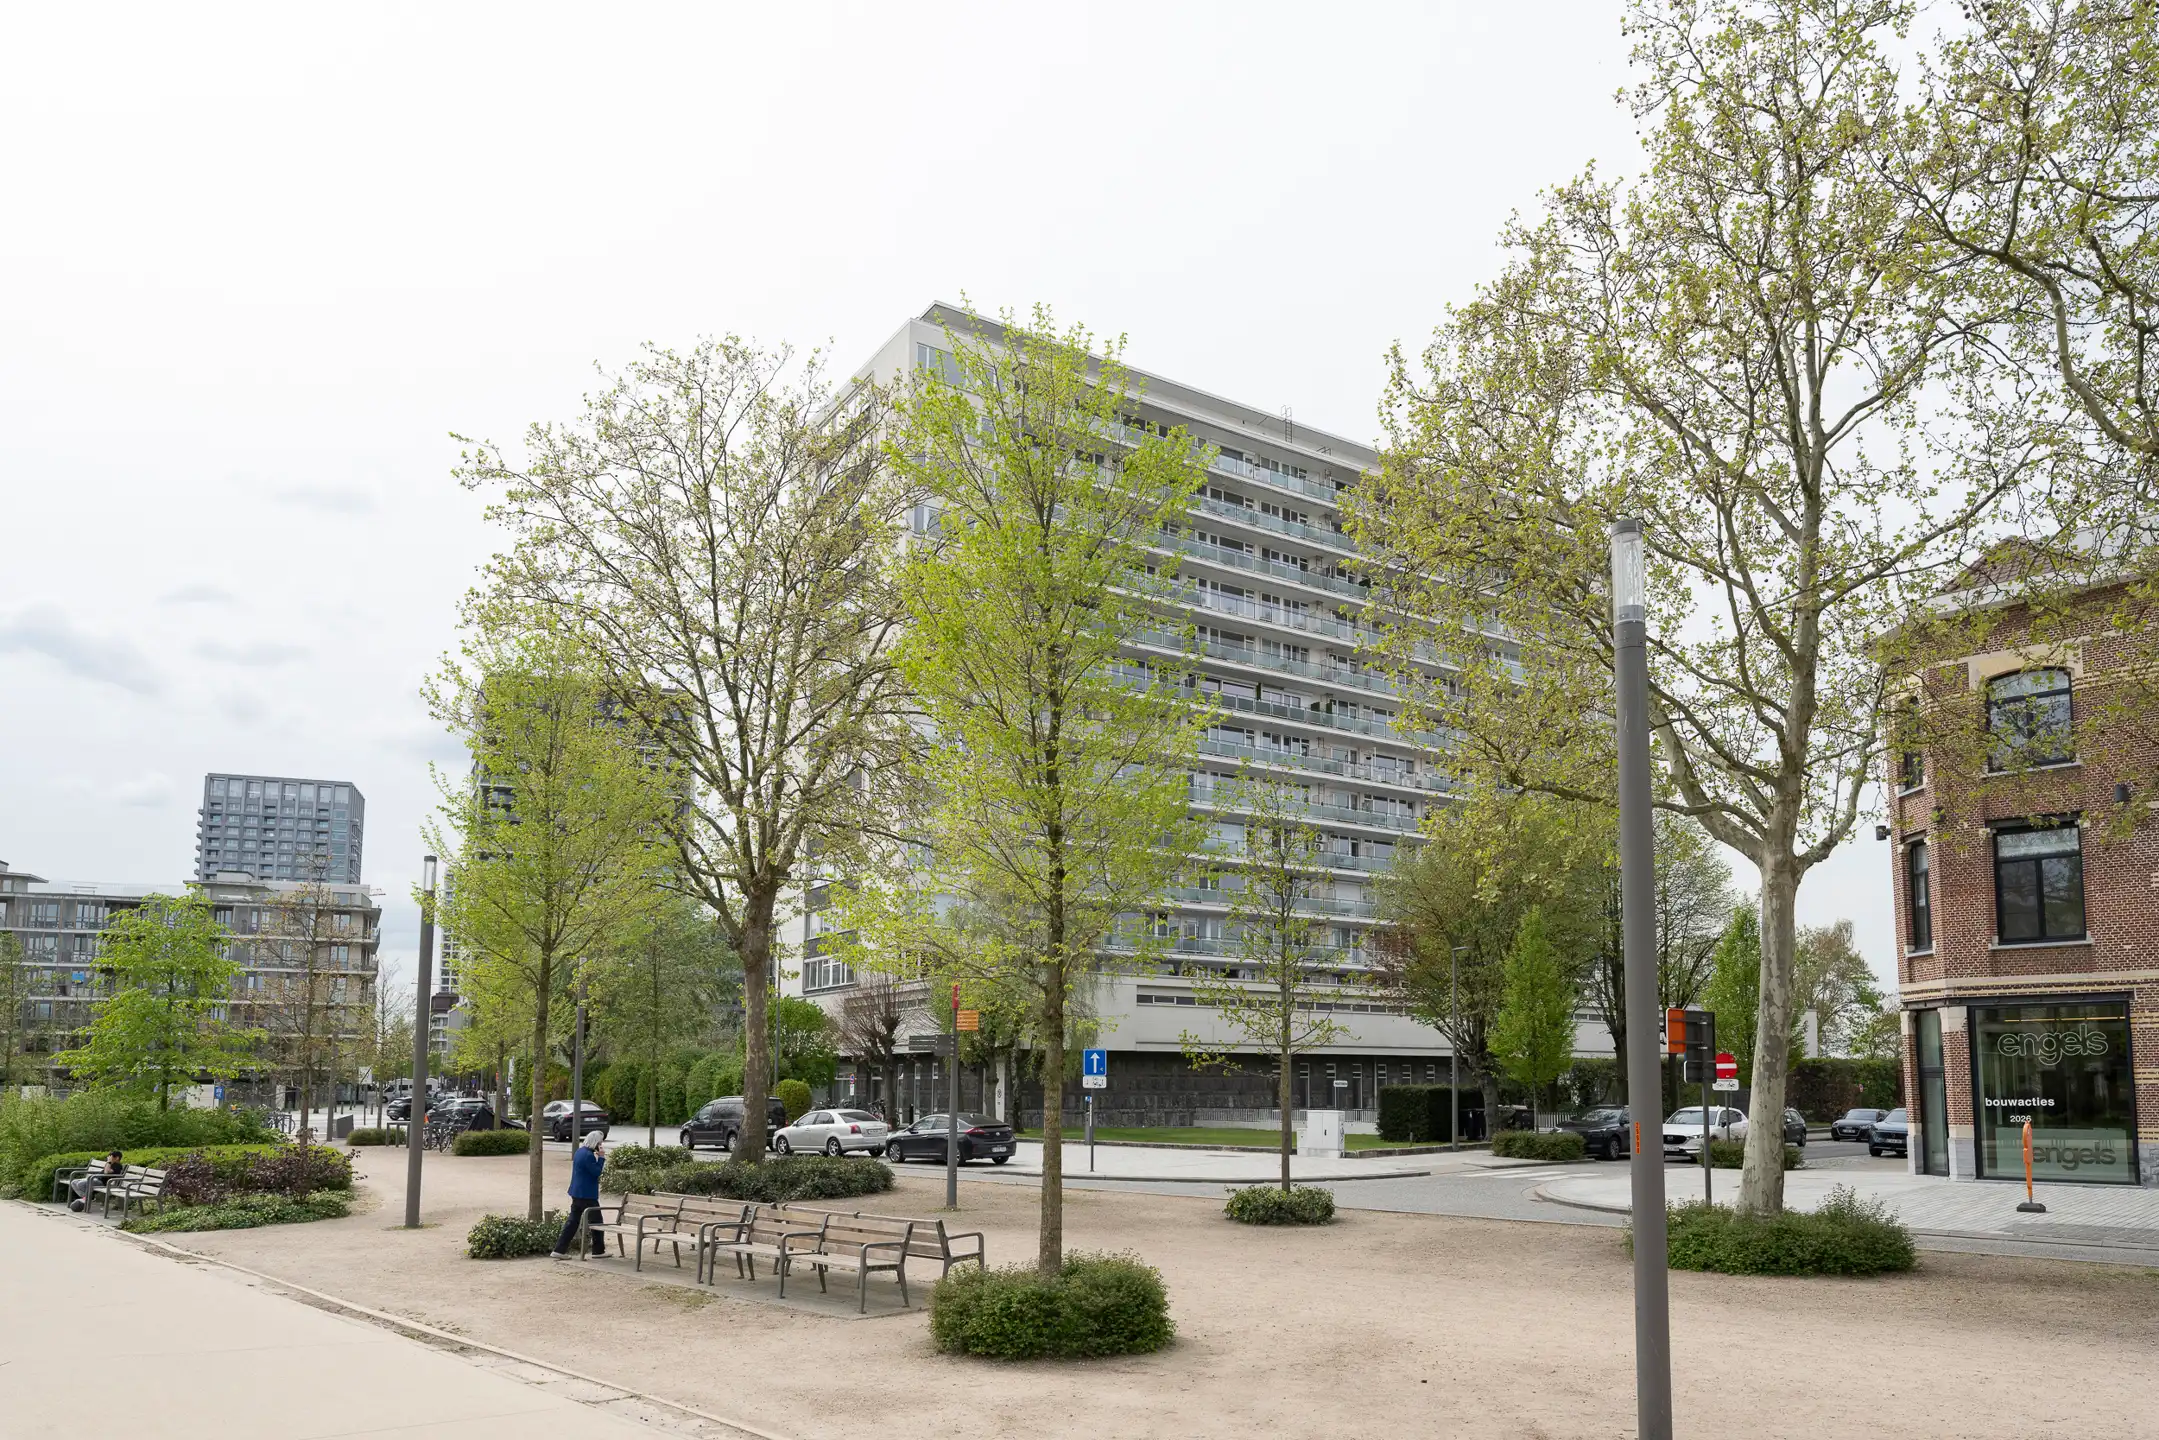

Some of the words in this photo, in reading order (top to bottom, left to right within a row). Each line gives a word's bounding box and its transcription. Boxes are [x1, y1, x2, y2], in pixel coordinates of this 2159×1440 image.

[1997, 1023, 2108, 1065] engels
[1985, 1097, 2055, 1107] bouwacties
[2010, 1115, 2032, 1123] 2026
[2032, 1142, 2116, 1171] engels
